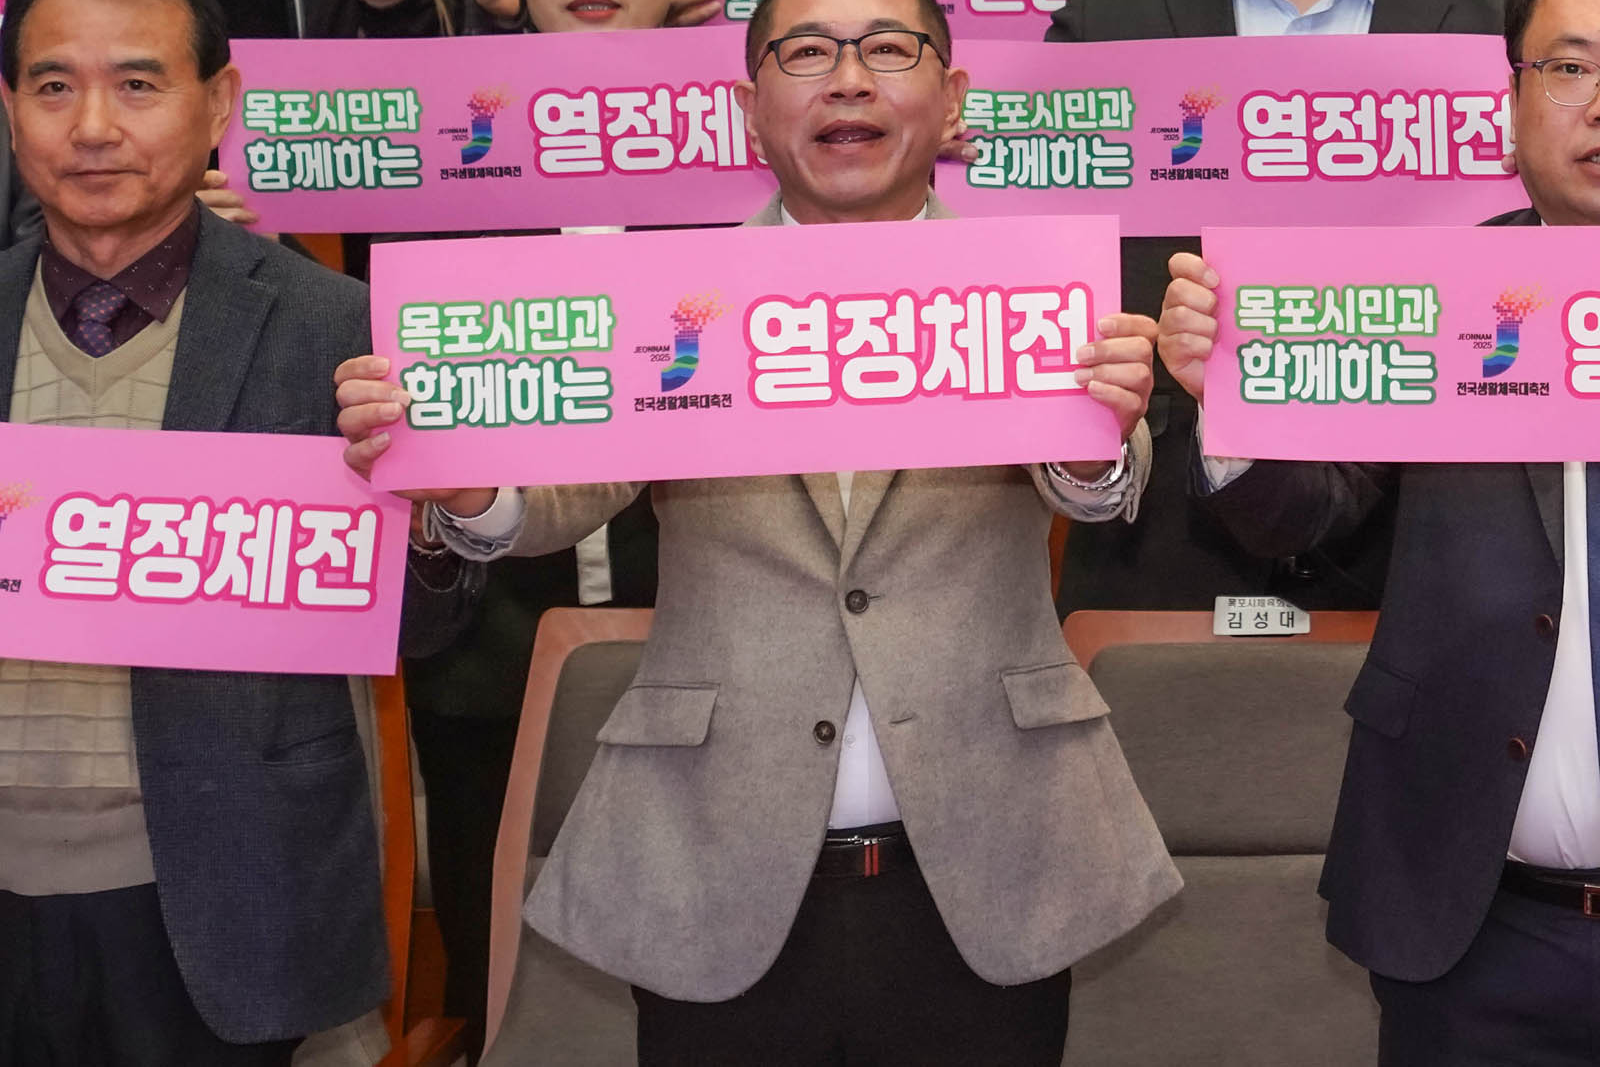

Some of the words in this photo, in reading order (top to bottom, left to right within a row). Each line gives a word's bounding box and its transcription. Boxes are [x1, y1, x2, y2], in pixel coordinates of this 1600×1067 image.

[243, 89, 420, 134] 목포시민과
[529, 84, 756, 177] 열정체
[962, 88, 1134, 132] 목포시민과
[1238, 89, 1517, 181] 열정체전
[246, 137, 422, 192] 함께하는
[440, 165, 523, 181] 전국생활체육대축전
[967, 136, 1134, 190] 함께하는
[1150, 168, 1229, 182] 전국생활체육대축전
[399, 295, 615, 358] 목포시민과
[1236, 284, 1442, 337] 목포시민과
[633, 345, 671, 355] JEONNAM
[649, 353, 671, 363] 2025
[745, 282, 1092, 409] 열정체전
[1457, 333, 1492, 341] JEONNAM
[1472, 341, 1493, 350] 2025
[402, 357, 613, 429] 함께하는
[1238, 338, 1438, 405] 함께하는
[1456, 381, 1550, 397] 전국생활체육대축전
[634, 394, 733, 412] 전국생활체육대축전
[40, 492, 383, 611] 열정체전
